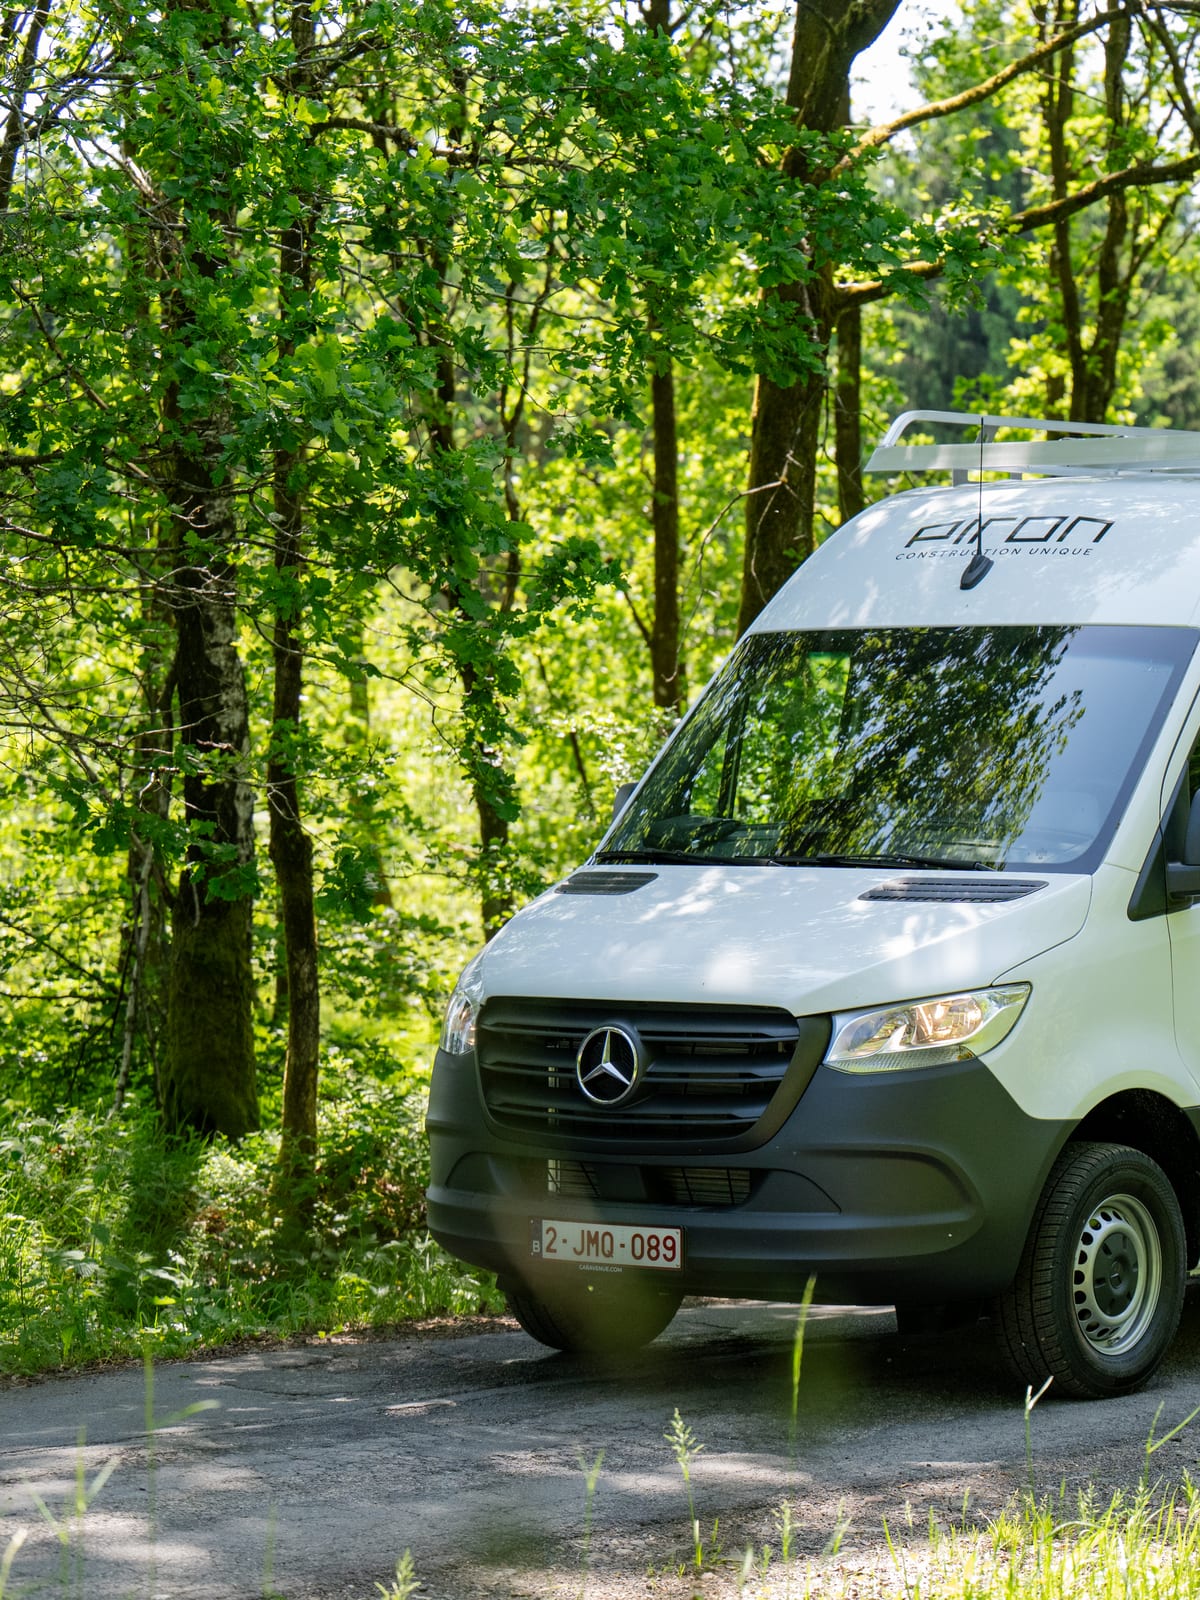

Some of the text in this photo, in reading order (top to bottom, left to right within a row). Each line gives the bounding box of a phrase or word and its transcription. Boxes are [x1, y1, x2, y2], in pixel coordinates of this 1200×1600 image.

[895, 547, 1093, 561] CONSTRUCTION UNIQUE
[532, 1226, 677, 1262] B 2-JMQ-089
